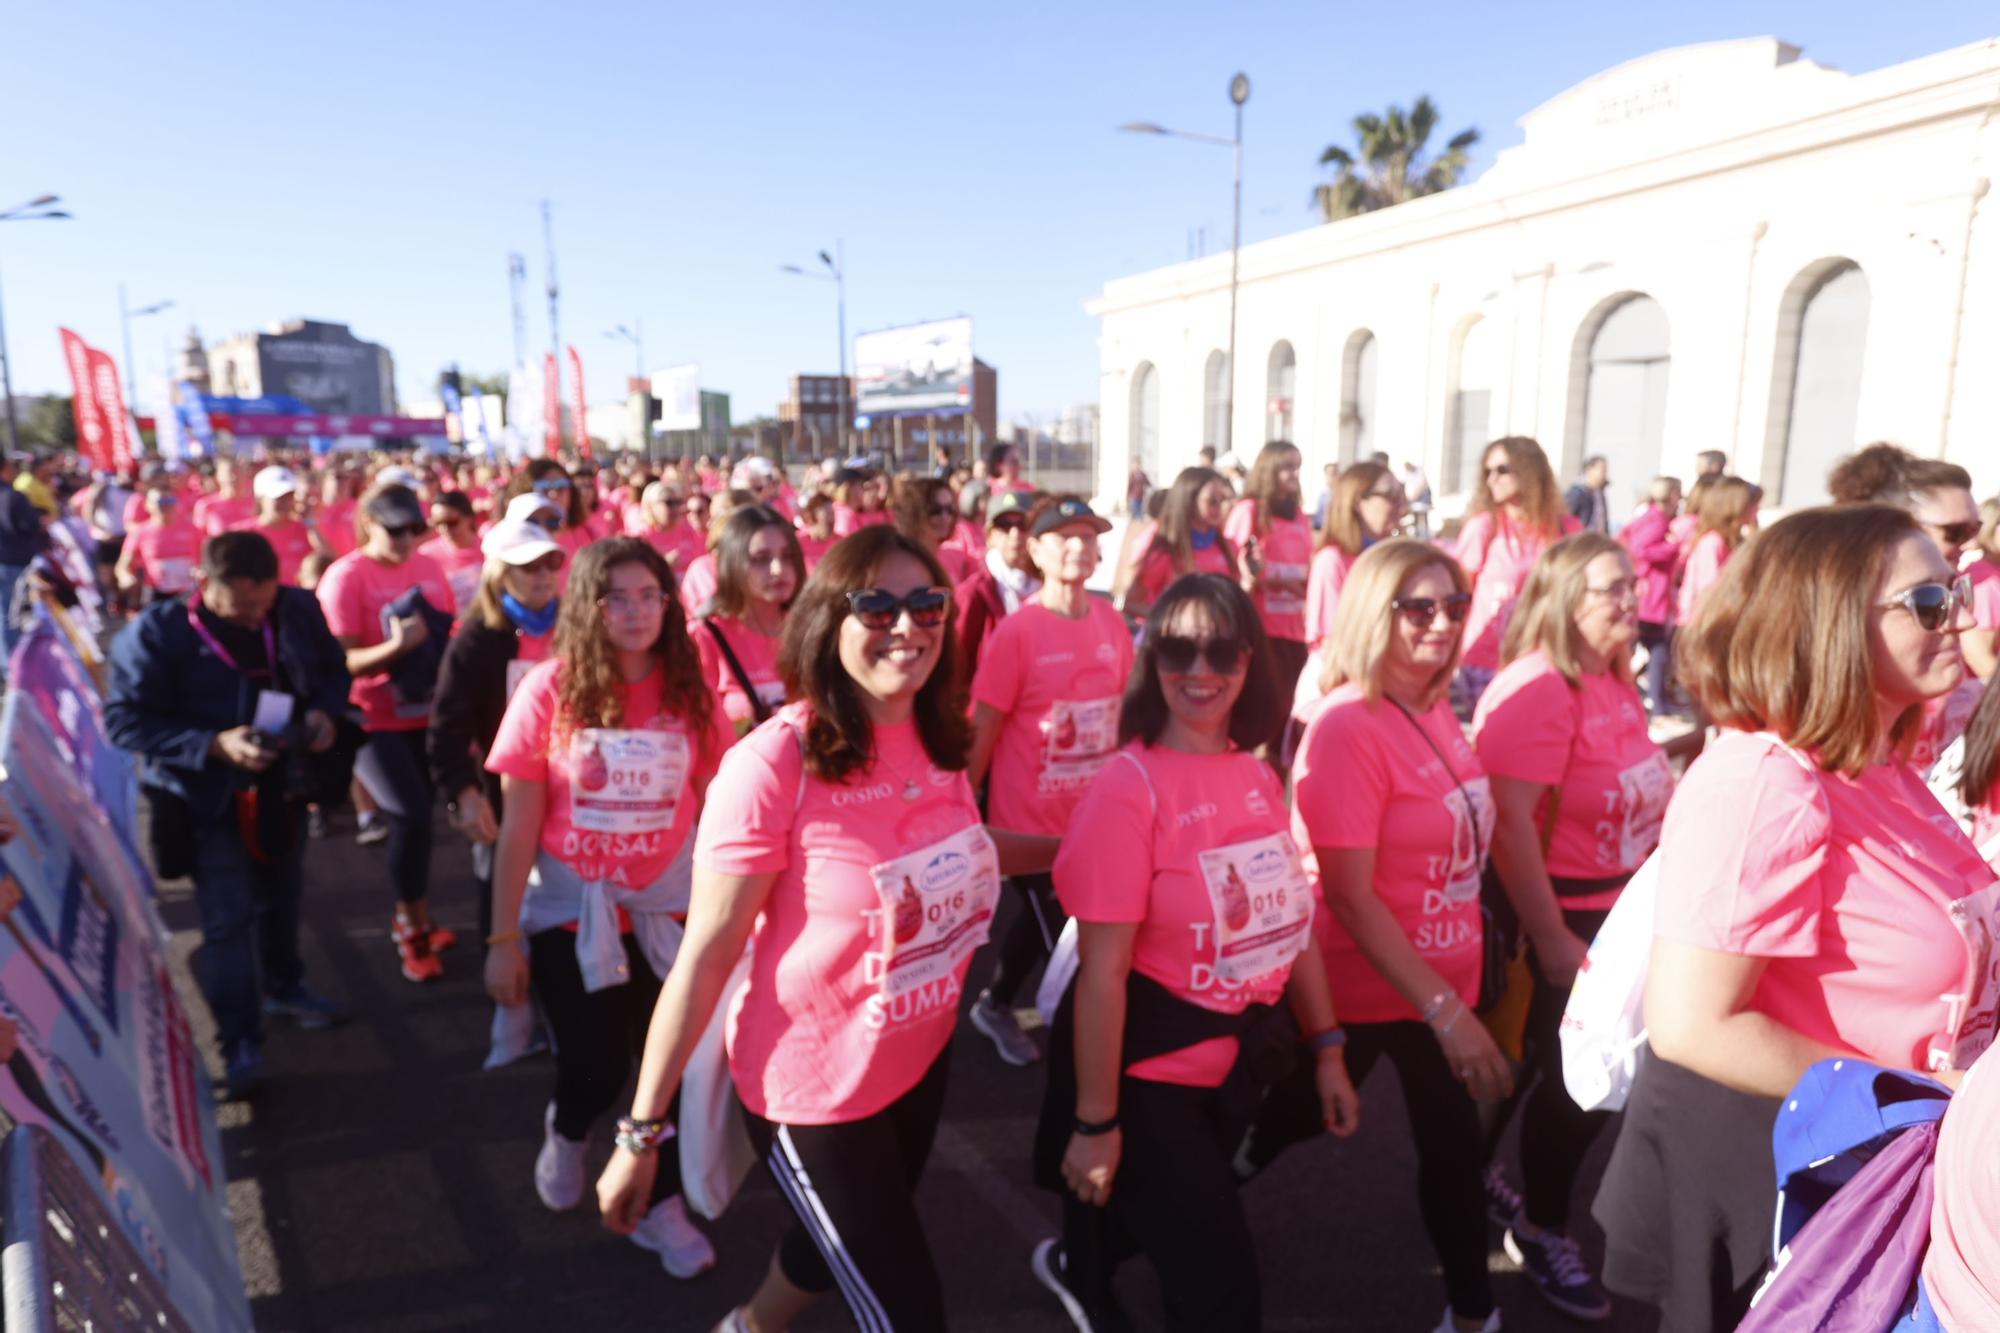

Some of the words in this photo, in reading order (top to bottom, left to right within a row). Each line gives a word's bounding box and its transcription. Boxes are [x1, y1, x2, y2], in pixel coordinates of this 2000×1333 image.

[612, 770, 651, 786] 016
[928, 890, 964, 922] 016
[1254, 888, 1287, 913] 016
[863, 972, 960, 1030] SUMA
